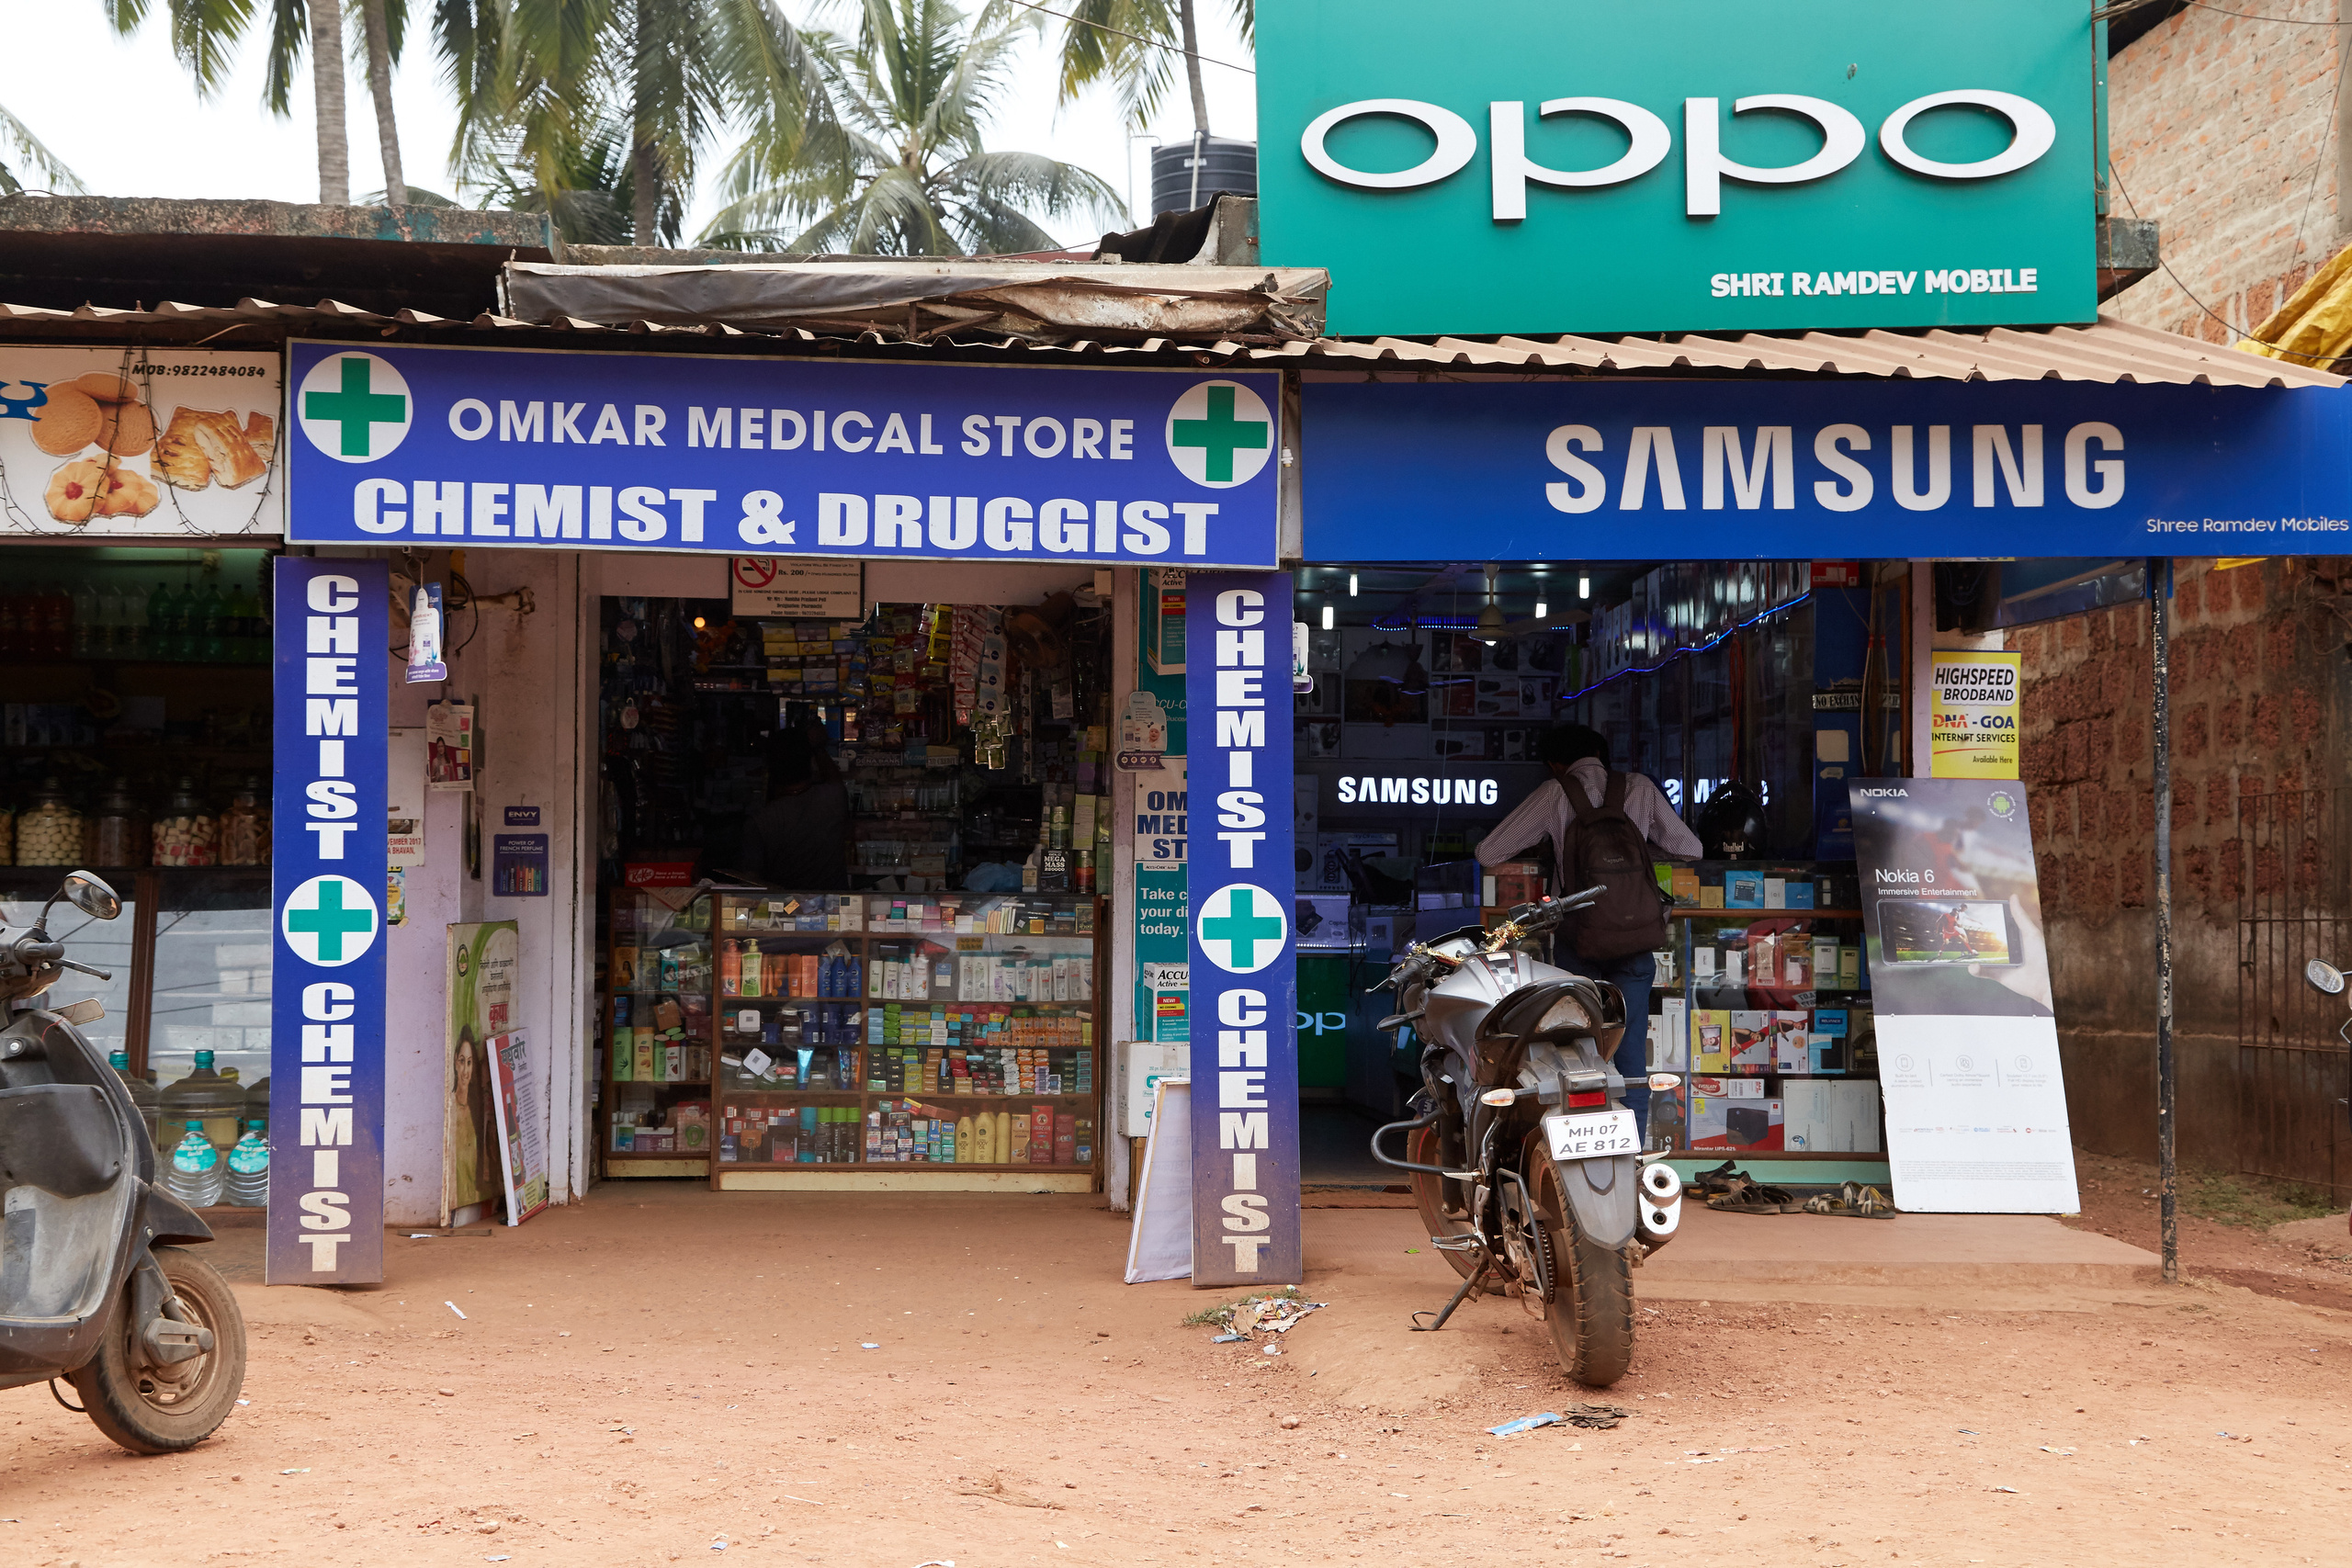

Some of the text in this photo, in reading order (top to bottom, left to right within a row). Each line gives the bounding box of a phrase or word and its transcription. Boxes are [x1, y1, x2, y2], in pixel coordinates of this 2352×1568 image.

[1301, 89, 2057, 220] oppo
[1710, 267, 2039, 299] SHRI RAMDEV MOBILE
[448, 399, 1135, 461] OMKAR MEDICAL STORE
[1545, 423, 2128, 514] SAMSUNG
[354, 479, 1220, 558] CHEMIST & DRUGGIST
[2147, 516, 2349, 533] Shree Ramdev Mobiles
[1935, 668, 2014, 686] HIGHSPEED
[1943, 688, 2014, 702] BRODBAND
[305, 574, 359, 860] CHEMIST
[1980, 715, 2015, 728] GOA
[1216, 589, 1266, 869] CHEMIST
[1976, 733, 2016, 743] SERVICES
[1973, 755, 2013, 764] Available Here
[1338, 776, 1498, 806] SAMSUNG
[1860, 788, 1909, 797] NOKIA
[1875, 868, 1935, 883] Nokia 6
[1140, 887, 1178, 900] Take
[1878, 887, 1977, 897] Immersive Entertainment
[1140, 908, 1172, 920] your
[1140, 923, 1183, 938] today.
[299, 981, 356, 1272] CHEMIST
[1217, 988, 1271, 1273] CHEMIST
[1568, 1124, 1618, 1138] MH 07
[1559, 1137, 1631, 1155] AE 812
